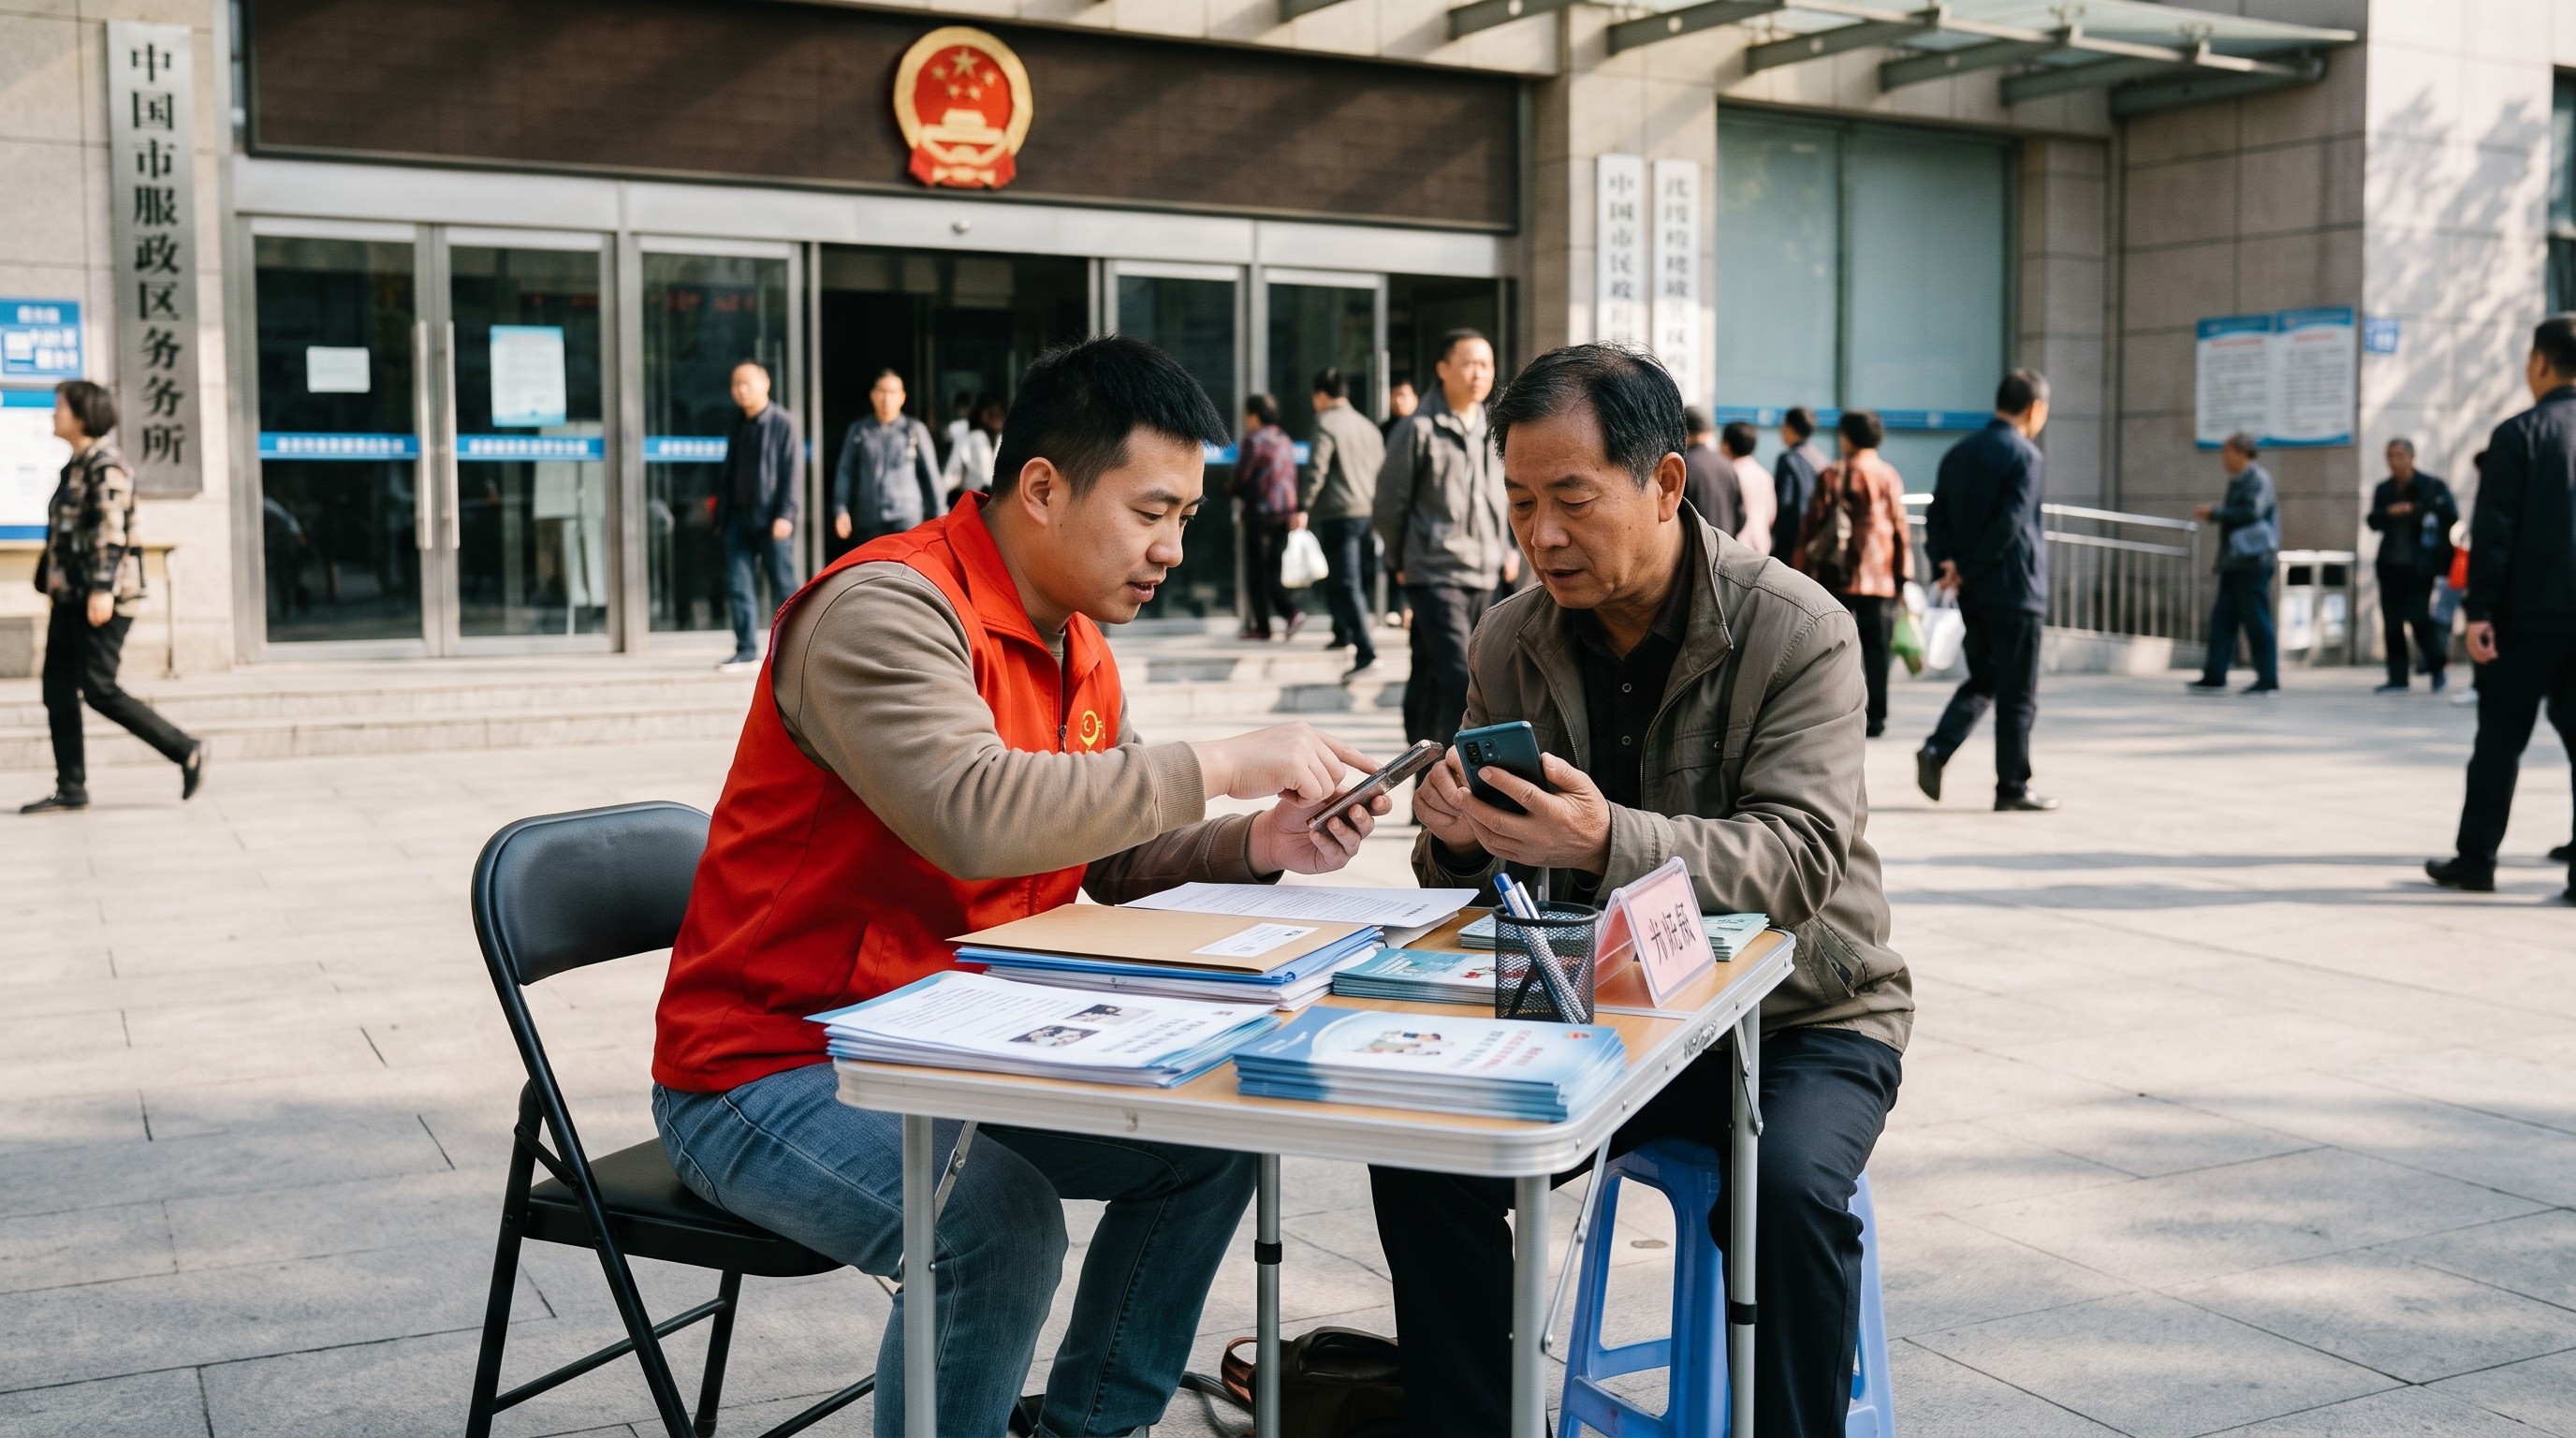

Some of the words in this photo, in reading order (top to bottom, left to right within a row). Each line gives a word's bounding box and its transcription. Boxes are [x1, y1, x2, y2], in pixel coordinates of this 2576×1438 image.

[131, 44, 184, 464] 中国市服政区务务所
